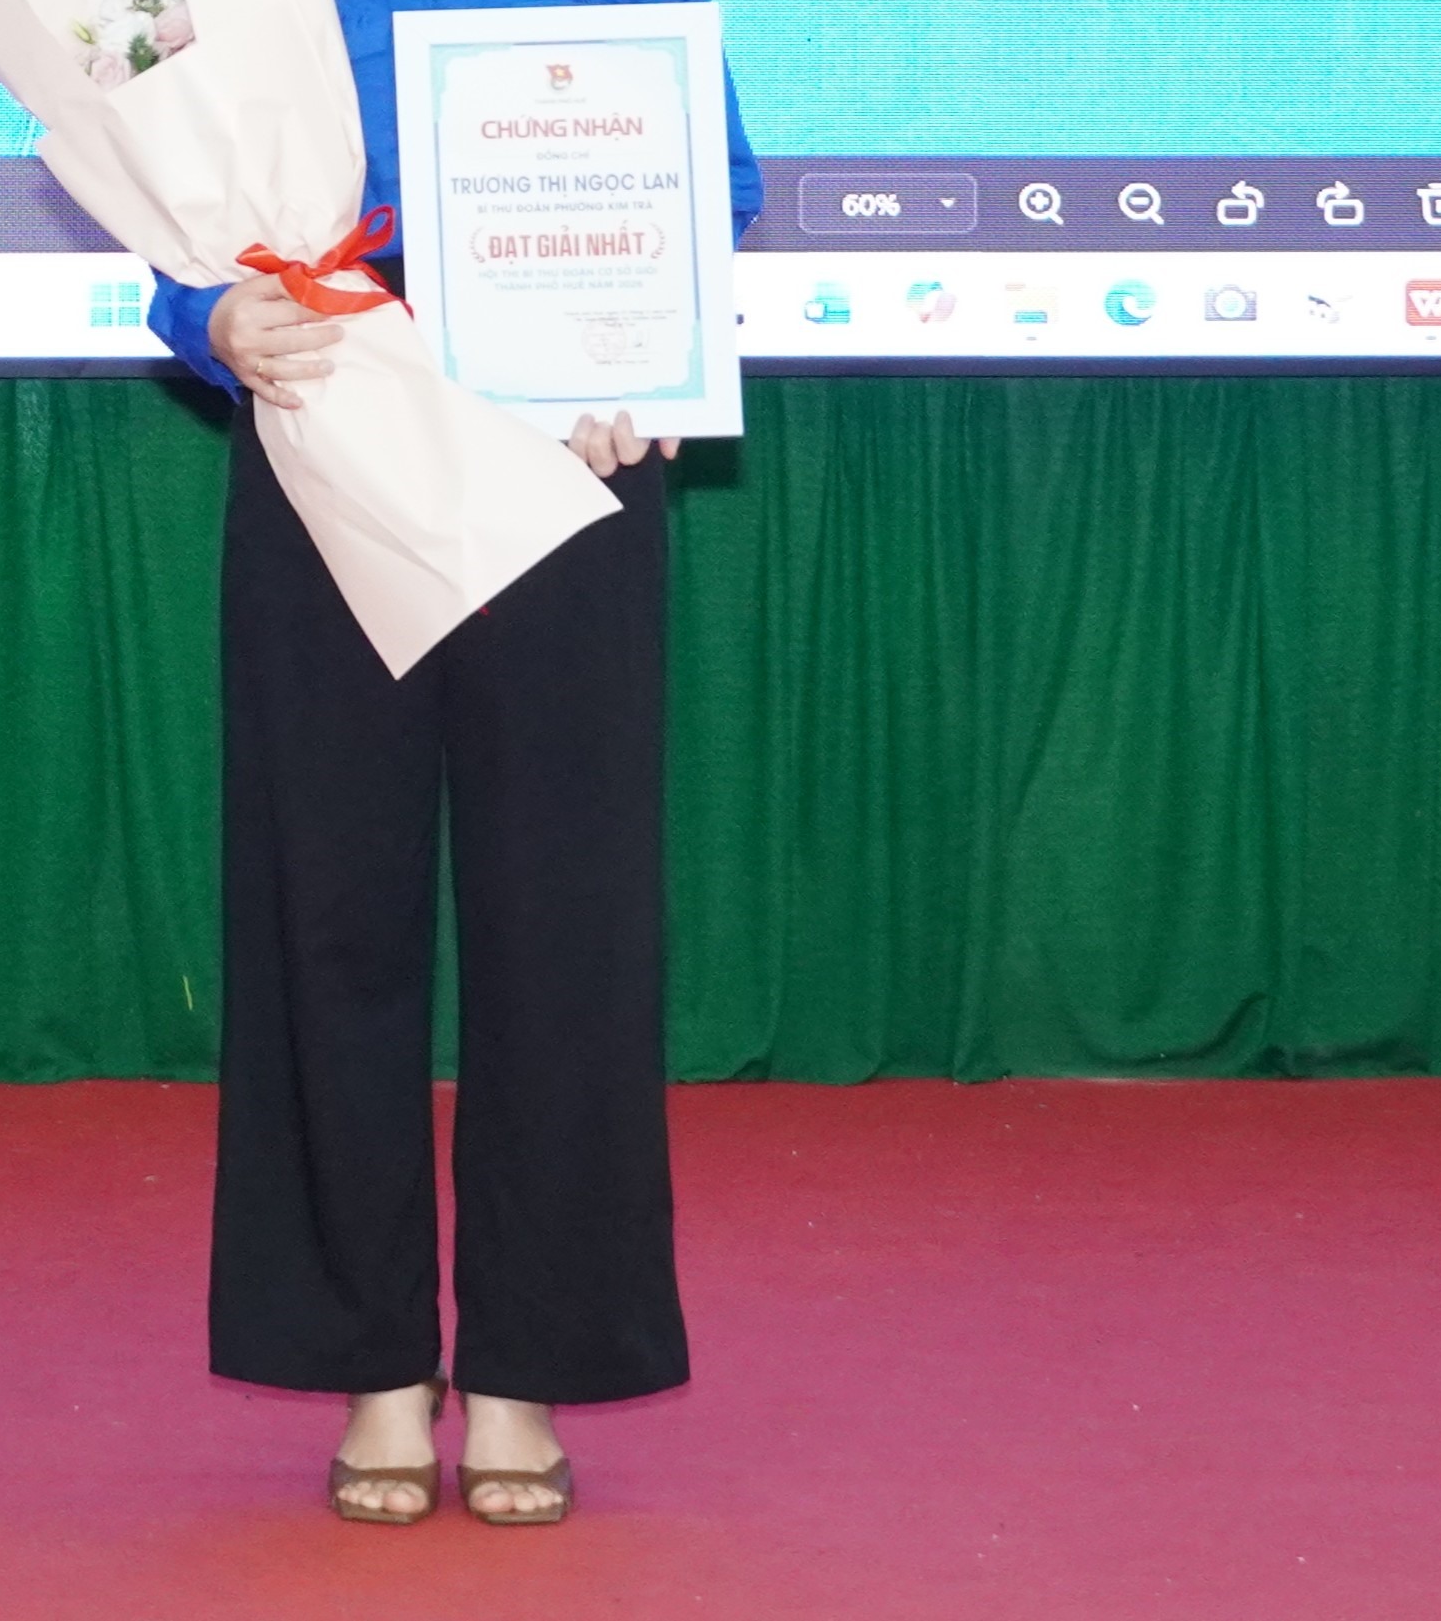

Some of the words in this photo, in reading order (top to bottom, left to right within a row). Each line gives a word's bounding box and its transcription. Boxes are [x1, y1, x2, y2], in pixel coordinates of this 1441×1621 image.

[481, 114, 568, 139] CHỨNG
[573, 112, 644, 141] NHẬN
[450, 174, 532, 194] TRƯƠNG
[538, 174, 568, 197] THỊ
[574, 173, 636, 196] NGỌC
[642, 172, 680, 190] LAN
[607, 200, 629, 211] KIM
[842, 194, 902, 217] 60%
[487, 233, 532, 265] ĐẠT
[536, 224, 581, 258] GIẢI
[585, 220, 646, 257] NHẤT
